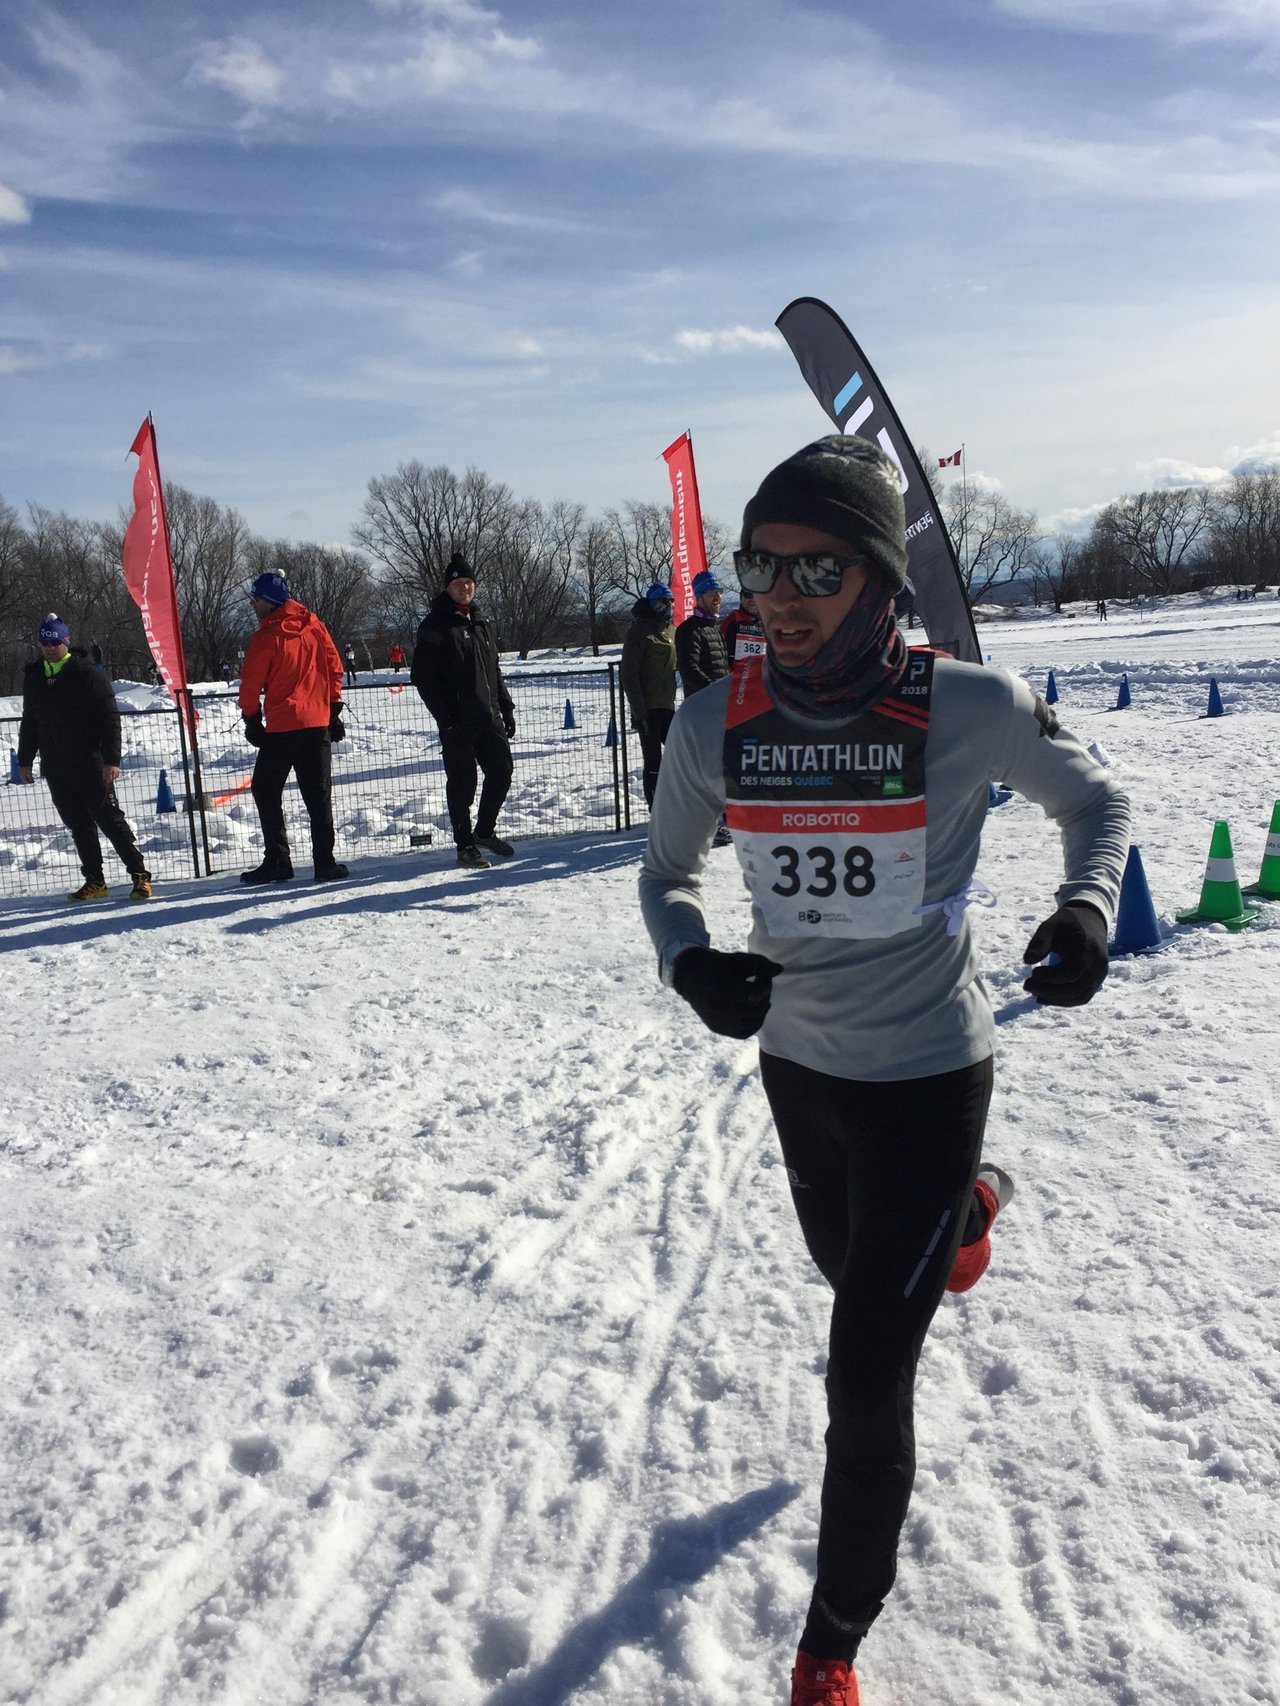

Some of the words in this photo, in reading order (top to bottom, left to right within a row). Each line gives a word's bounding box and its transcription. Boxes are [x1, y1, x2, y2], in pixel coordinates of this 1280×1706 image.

[744, 643, 761, 654] 362
[901, 686, 928, 695] 2018
[741, 744, 903, 771] PENTATHLON
[740, 775, 758, 786] DES
[759, 775, 792, 786] NEIGES
[794, 774, 833, 786] QUÉBEC
[783, 813, 860, 826] ROBOTIQ
[771, 845, 876, 897] 338
